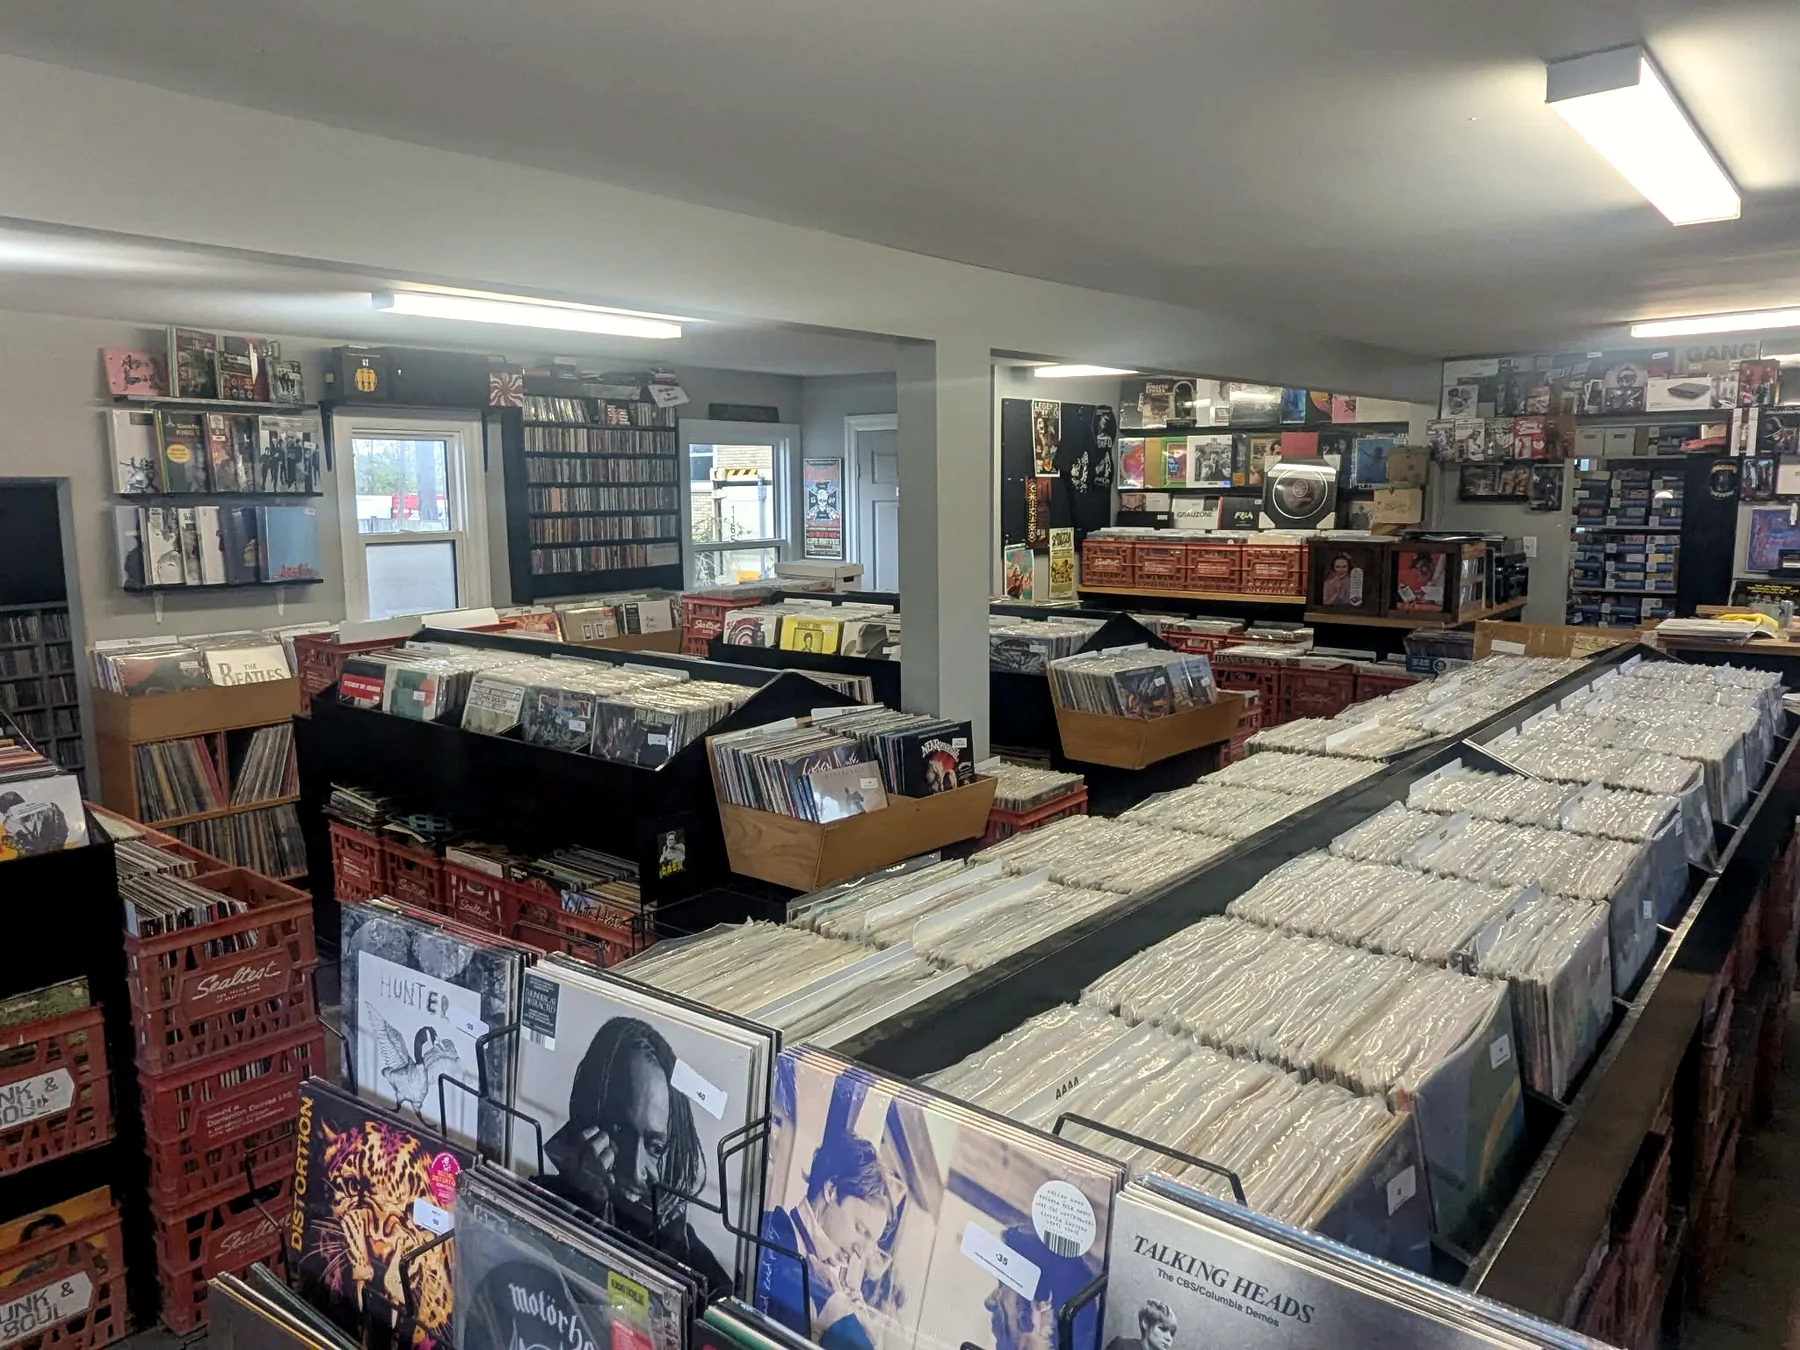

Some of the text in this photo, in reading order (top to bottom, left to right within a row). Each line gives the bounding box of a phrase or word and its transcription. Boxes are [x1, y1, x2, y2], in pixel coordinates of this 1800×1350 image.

[1686, 342, 1757, 362] GANG
[244, 663, 258, 671] THE
[191, 960, 282, 1001] Sealtest
[380, 975, 451, 1023] HUNTER
[1055, 1076, 1080, 1101] AAAA
[291, 1096, 315, 1251] DISTORTION
[60, 1281, 74, 1298] &
[1133, 1235, 1315, 1324] TALKING HEADS
[1157, 1267, 1280, 1328] The CBS/Columbia Demos
